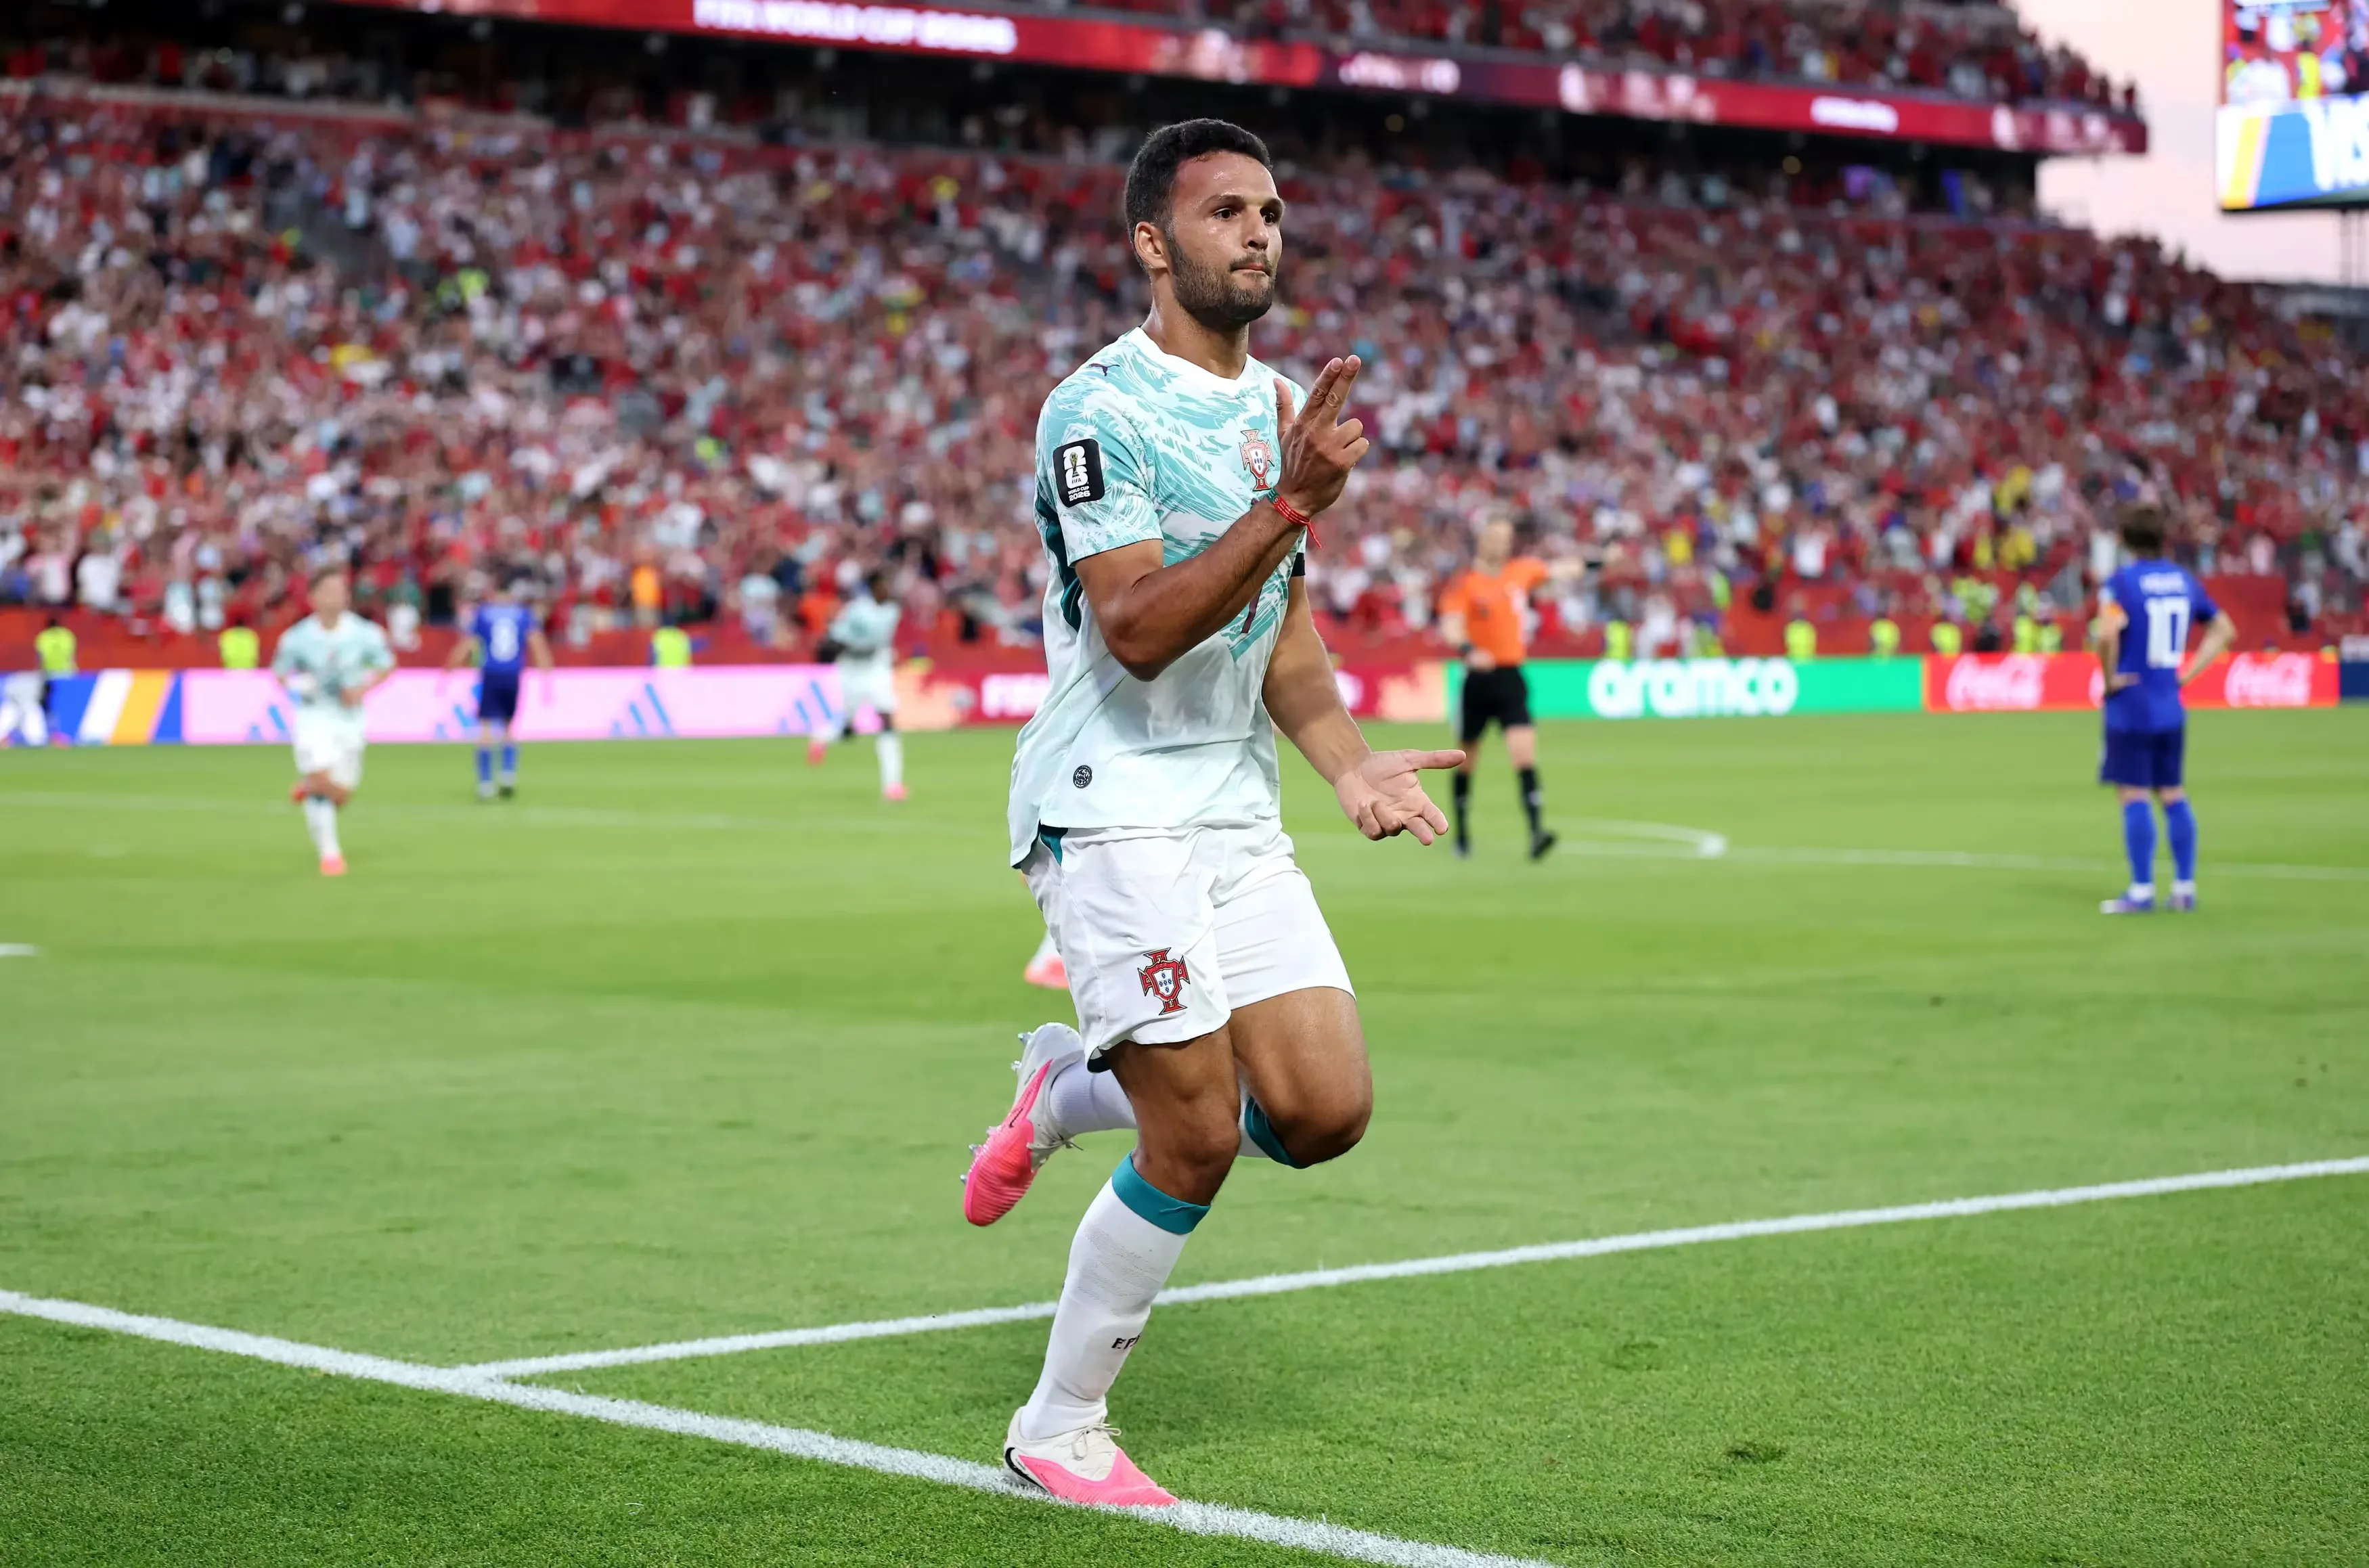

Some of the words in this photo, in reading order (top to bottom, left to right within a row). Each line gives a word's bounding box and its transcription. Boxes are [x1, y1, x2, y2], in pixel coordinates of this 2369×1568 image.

[1069, 491, 1090, 501] 2026
[2144, 597, 2190, 669] 10
[1587, 658, 1798, 718] aramco
